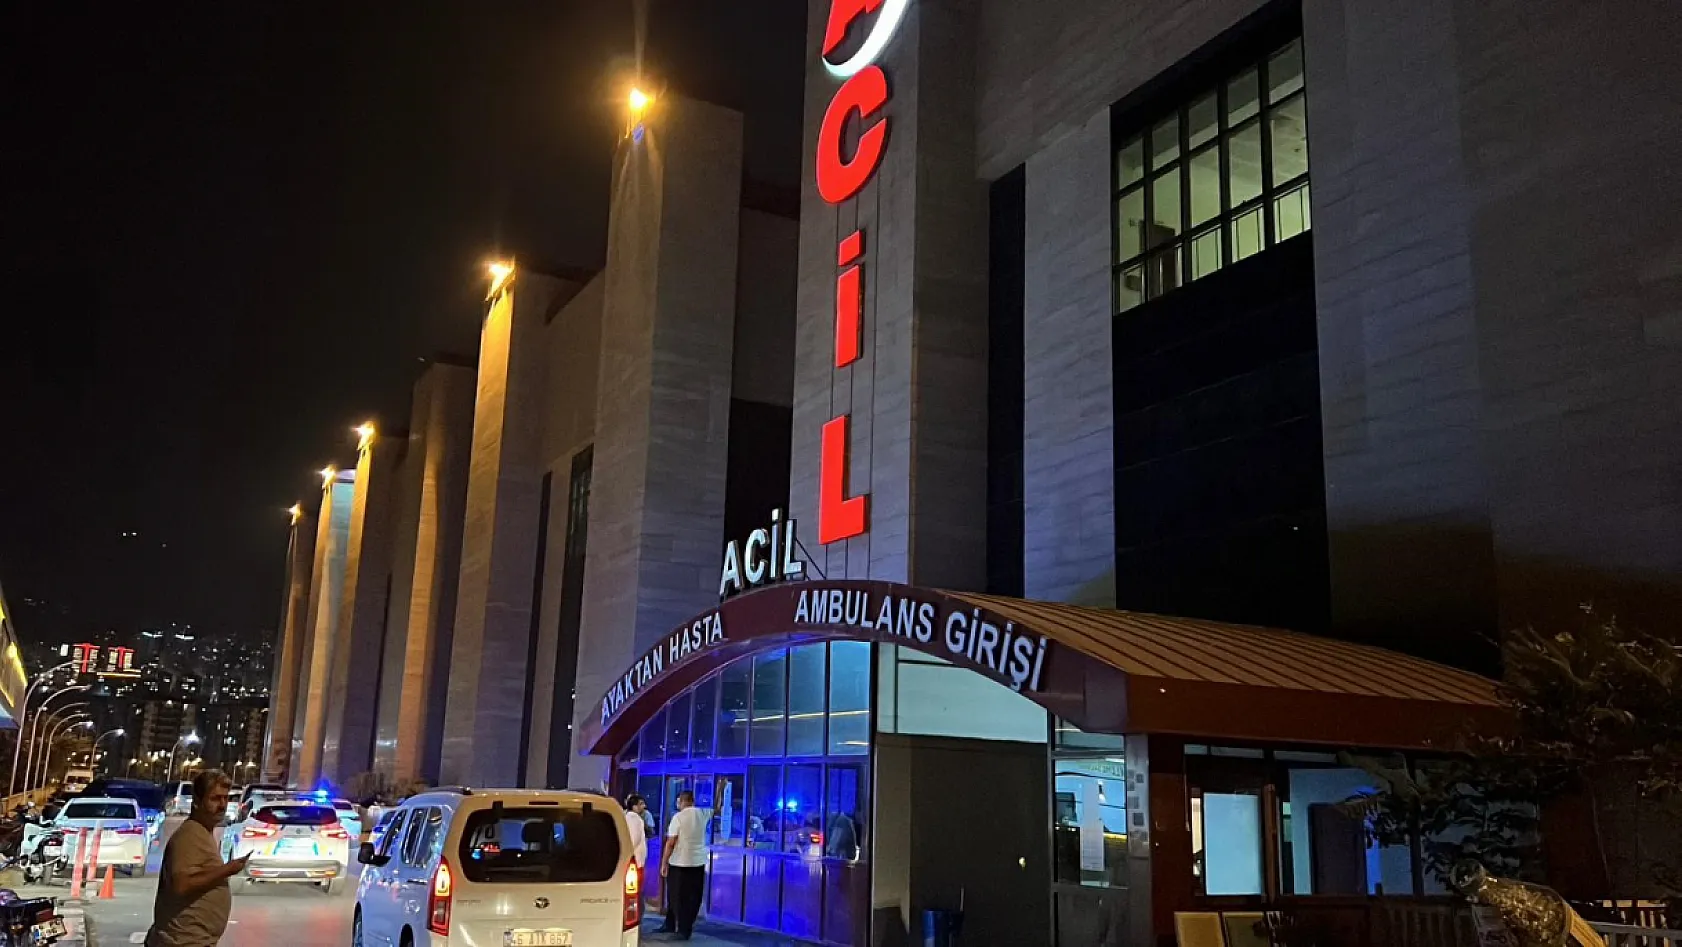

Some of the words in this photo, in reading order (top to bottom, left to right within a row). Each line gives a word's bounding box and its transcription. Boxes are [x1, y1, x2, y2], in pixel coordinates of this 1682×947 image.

[720, 508, 802, 595] ACİL
[600, 645, 663, 726] AYAKTAN
[669, 611, 723, 665] HASTA
[794, 590, 935, 643] AMBULANS
[945, 608, 1048, 693] GİRİŞİ
